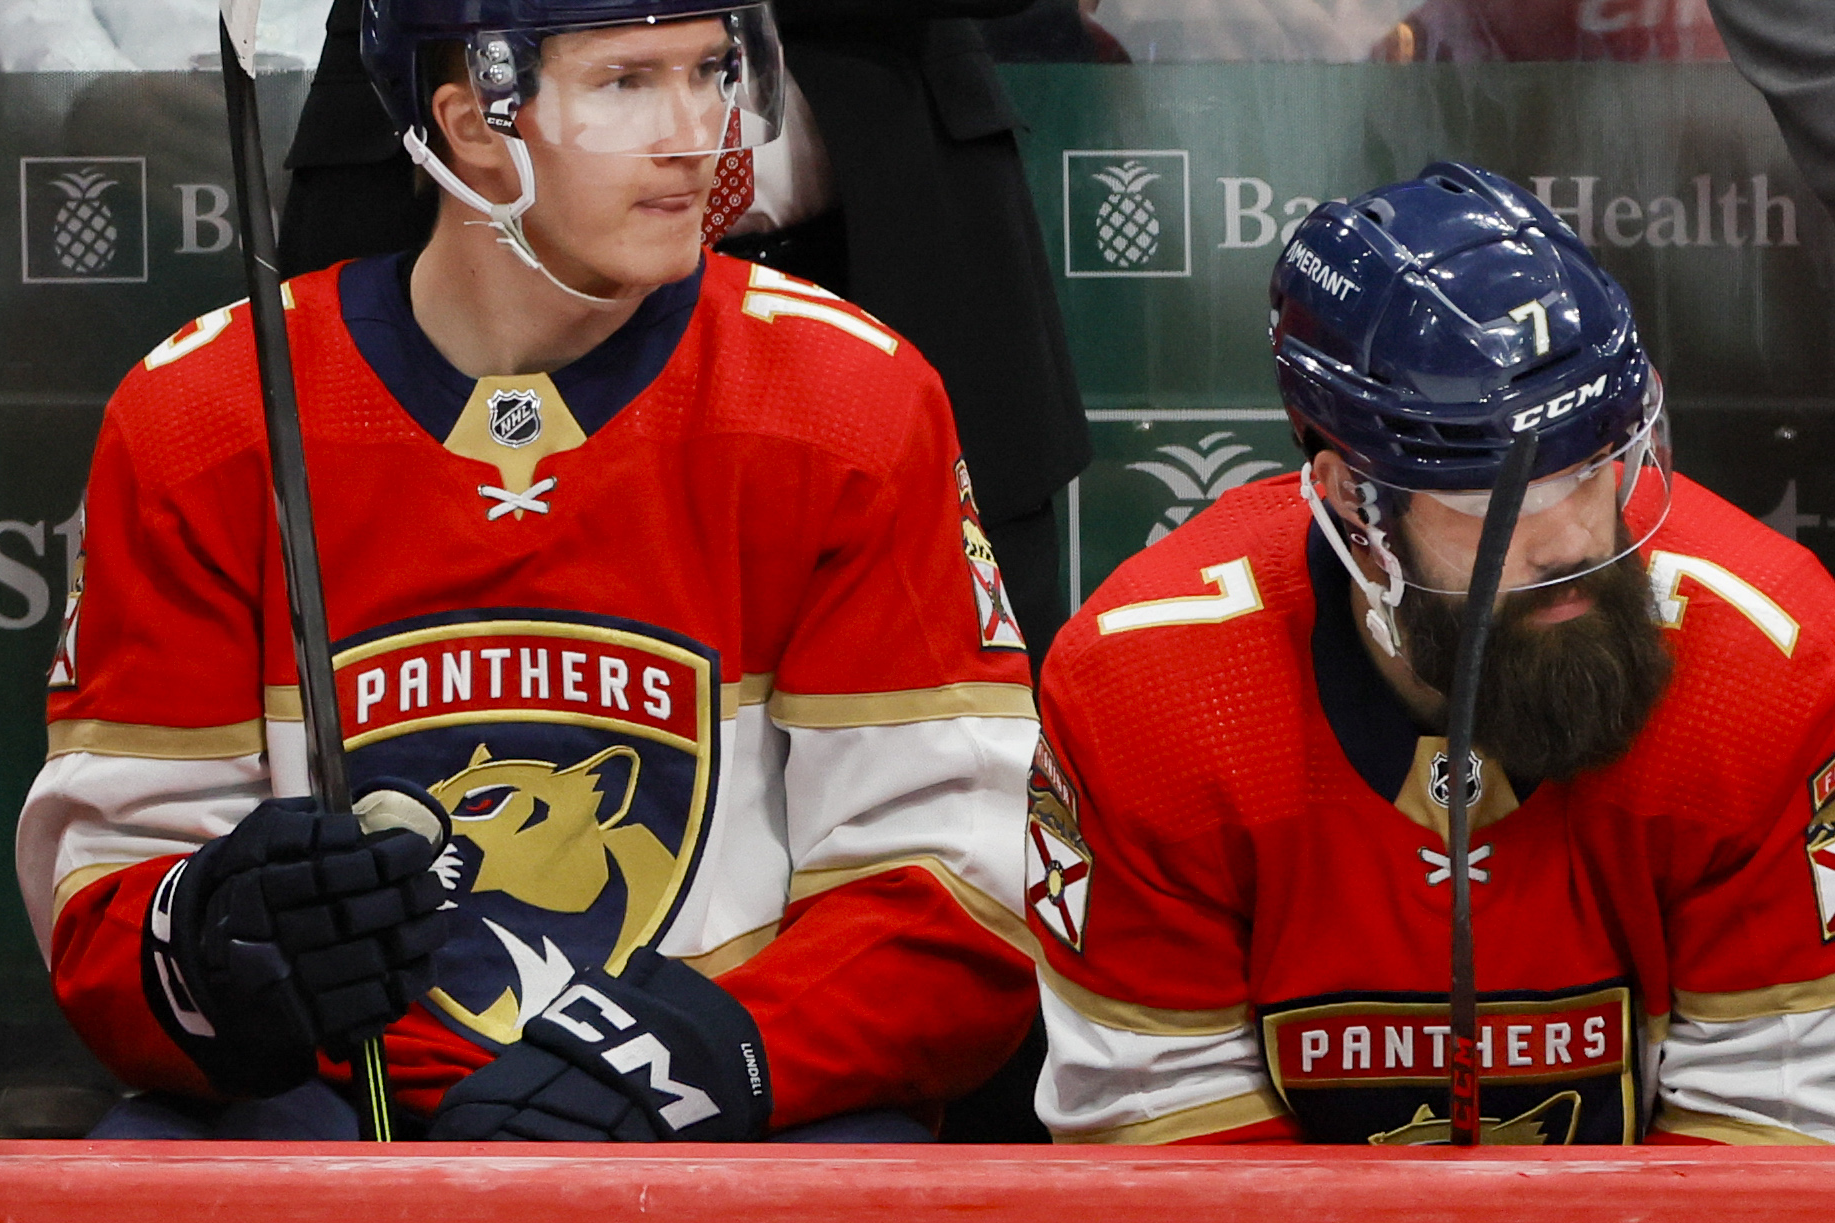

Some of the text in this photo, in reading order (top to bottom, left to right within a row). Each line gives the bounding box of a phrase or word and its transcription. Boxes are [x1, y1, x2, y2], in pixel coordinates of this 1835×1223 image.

[1530, 173, 1801, 247] Health
[1286, 239, 1357, 301] AMERANT
[1509, 299, 1551, 356] 7
[1511, 374, 1608, 433] CCM
[357, 647, 672, 724] PANTHERS
[740, 1042, 764, 1097] LUNDELL
